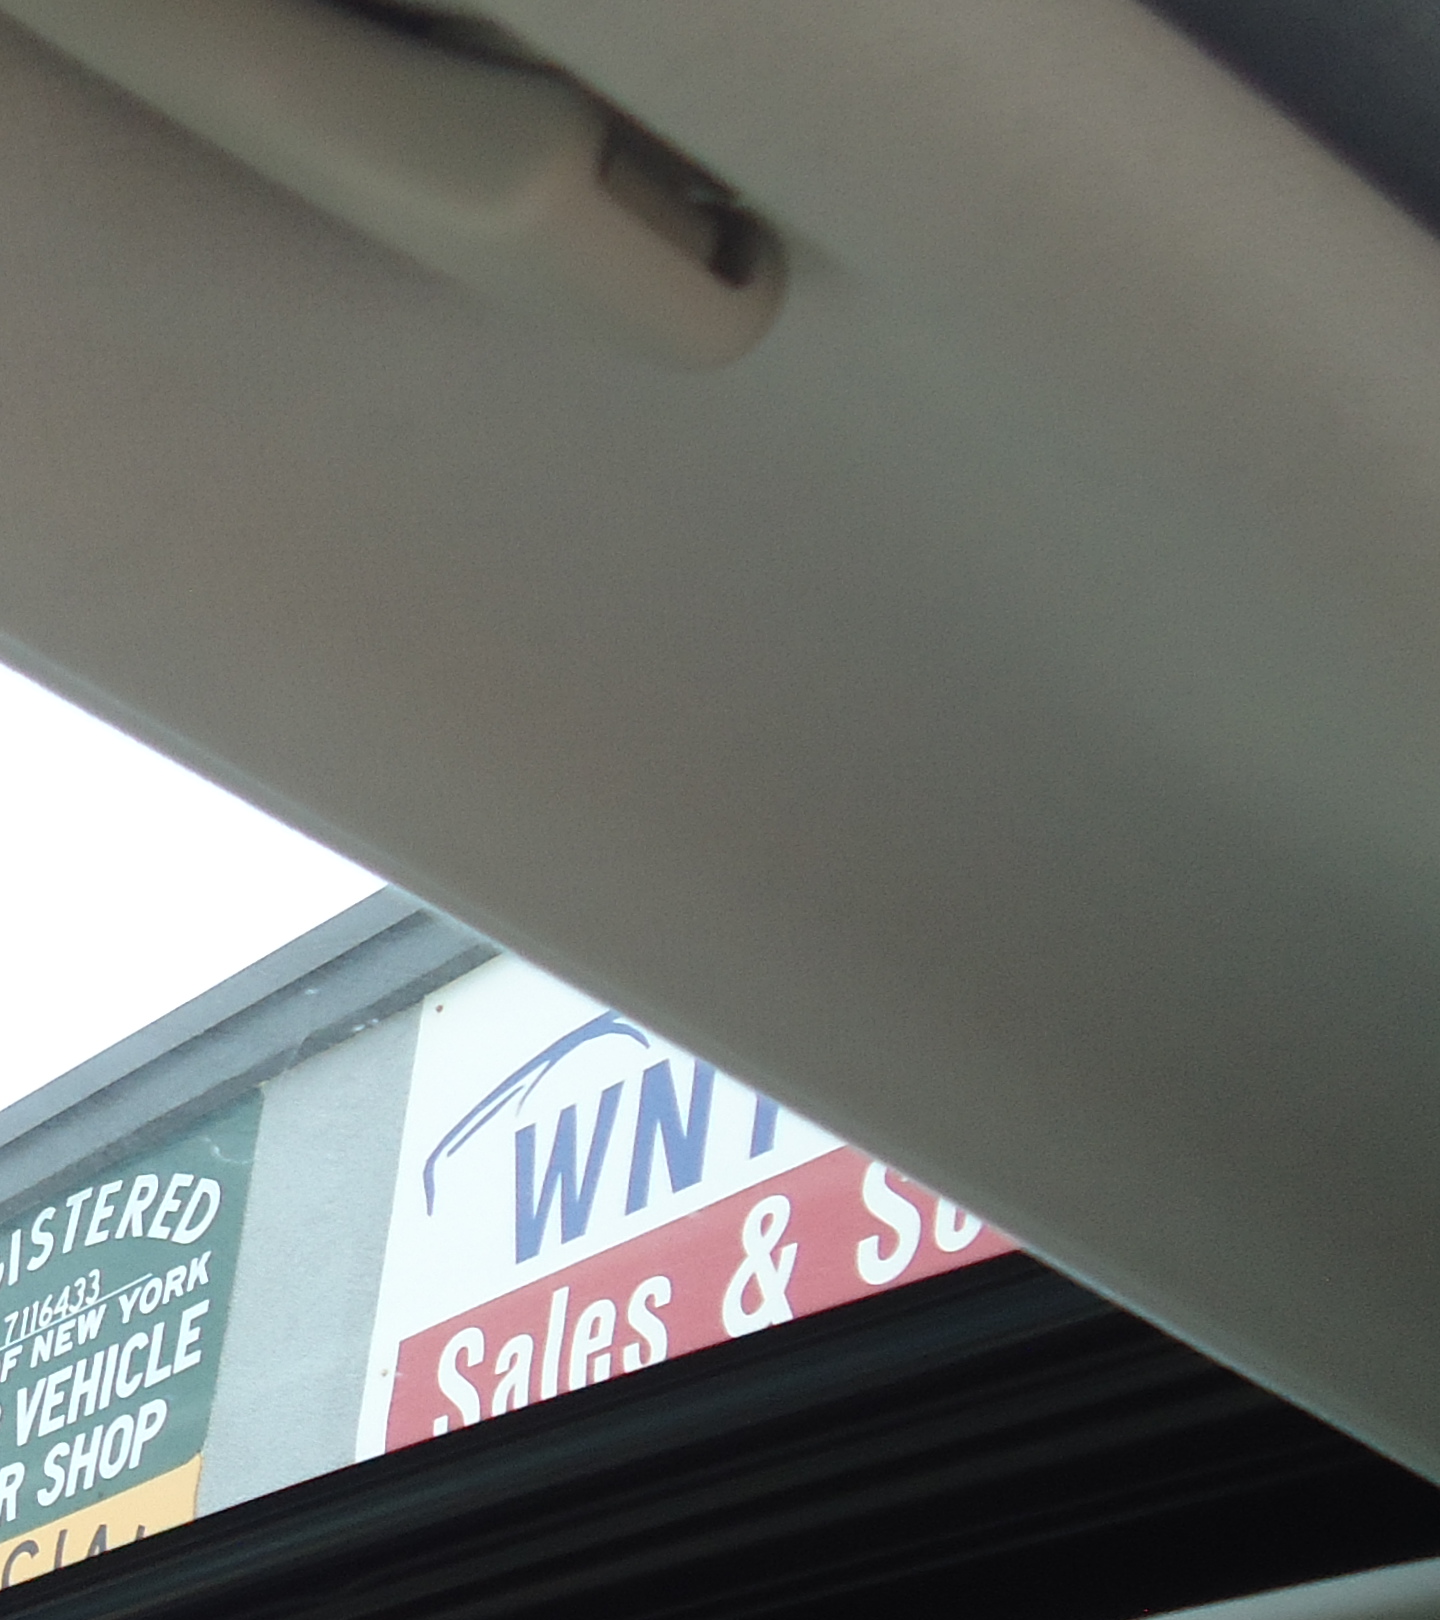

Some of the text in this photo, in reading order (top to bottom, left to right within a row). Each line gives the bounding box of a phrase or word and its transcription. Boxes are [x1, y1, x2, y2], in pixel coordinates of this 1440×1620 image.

[3, 1268, 102, 1347] 7116433
[30, 1303, 107, 1368] NEW
[119, 1250, 213, 1324] YORK
[433, 1275, 672, 1437] Sales
[721, 1194, 799, 1338] &
[16, 1299, 210, 1446] VEHICLE
[37, 1399, 168, 1507] SHOP
